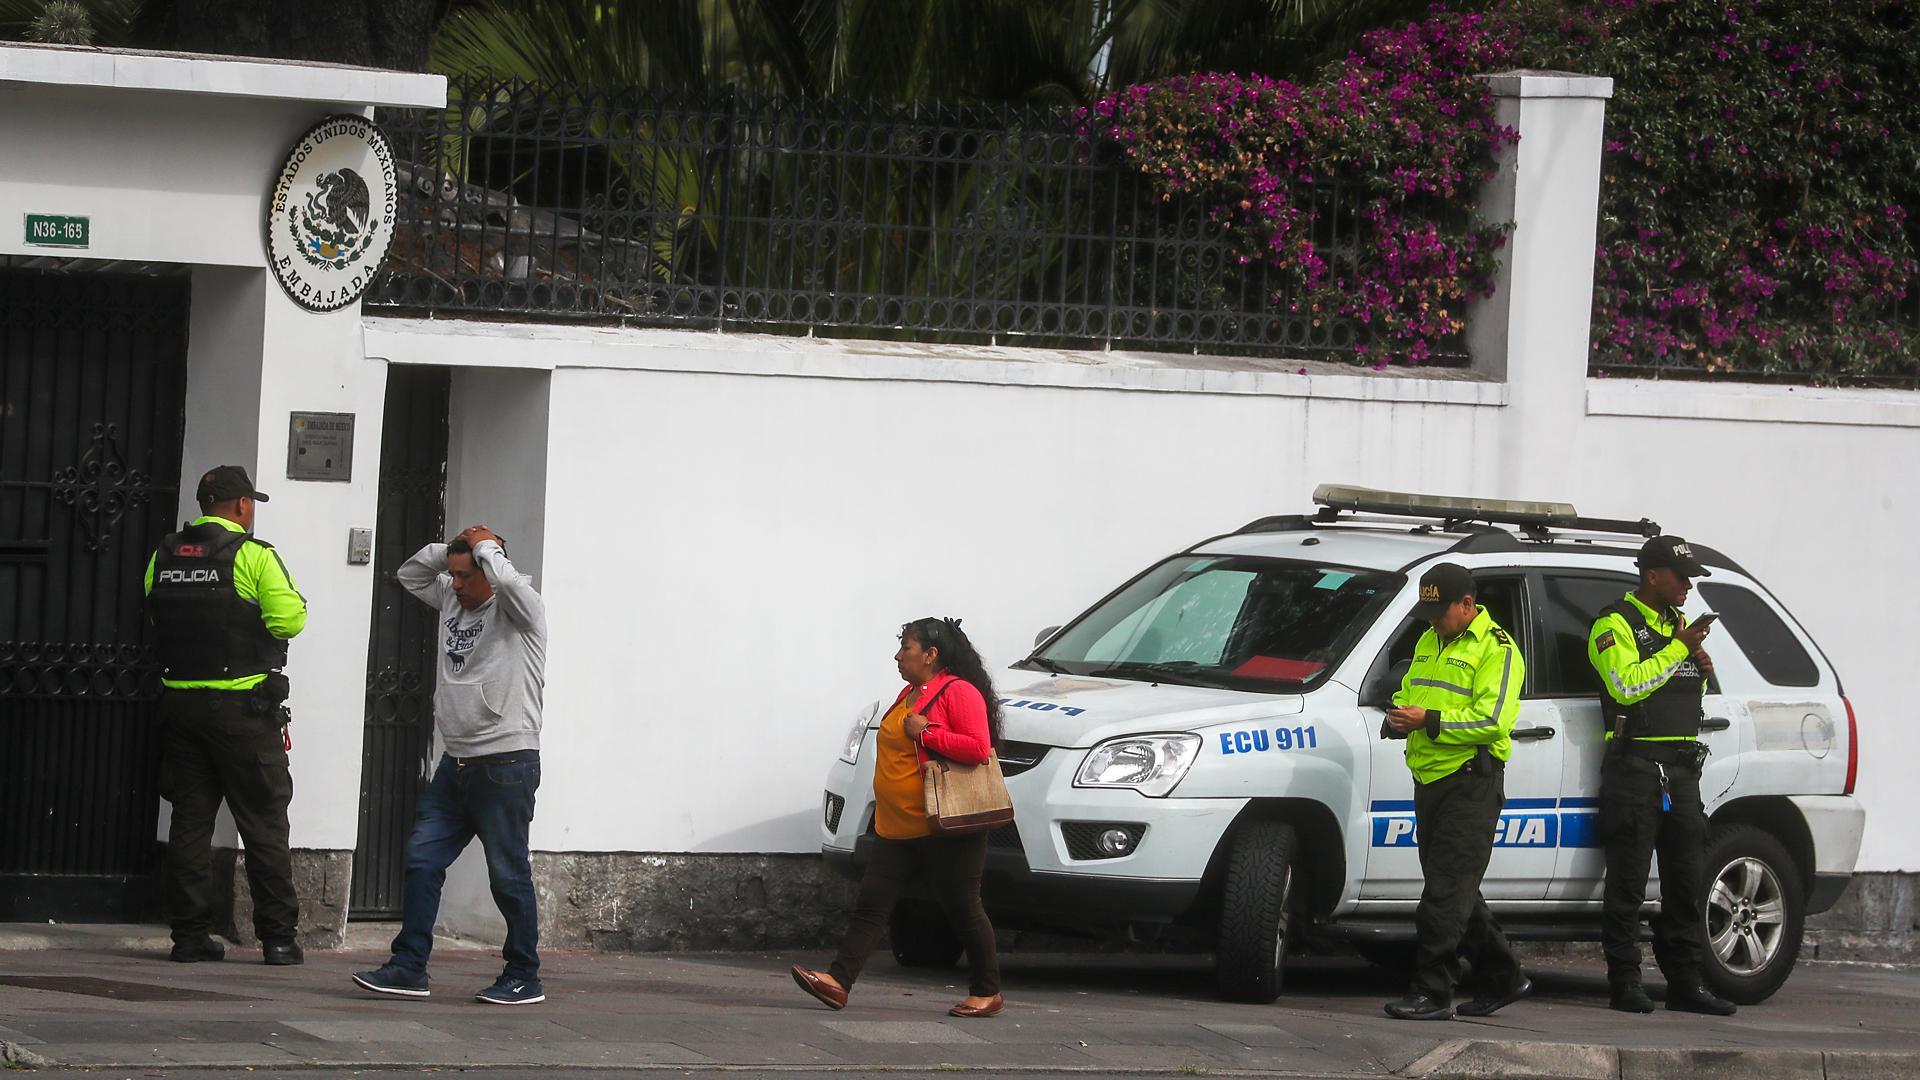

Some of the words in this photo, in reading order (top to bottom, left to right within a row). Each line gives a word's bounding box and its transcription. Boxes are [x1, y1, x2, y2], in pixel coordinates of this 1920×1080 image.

[276, 143, 313, 213] ESTADOS
[313, 123, 367, 144] UNIDOS
[367, 135, 394, 225] MEXICANOS
[33, 221, 83, 239] N36-165
[279, 255, 374, 303] EMBAJADA
[1672, 543, 1692, 556] POLI
[159, 569, 219, 582] POLICIA
[446, 636, 455, 647] &
[1219, 729, 1269, 755] ECU
[1275, 725, 1317, 750] 911
[1384, 818, 1546, 845] PCIA
